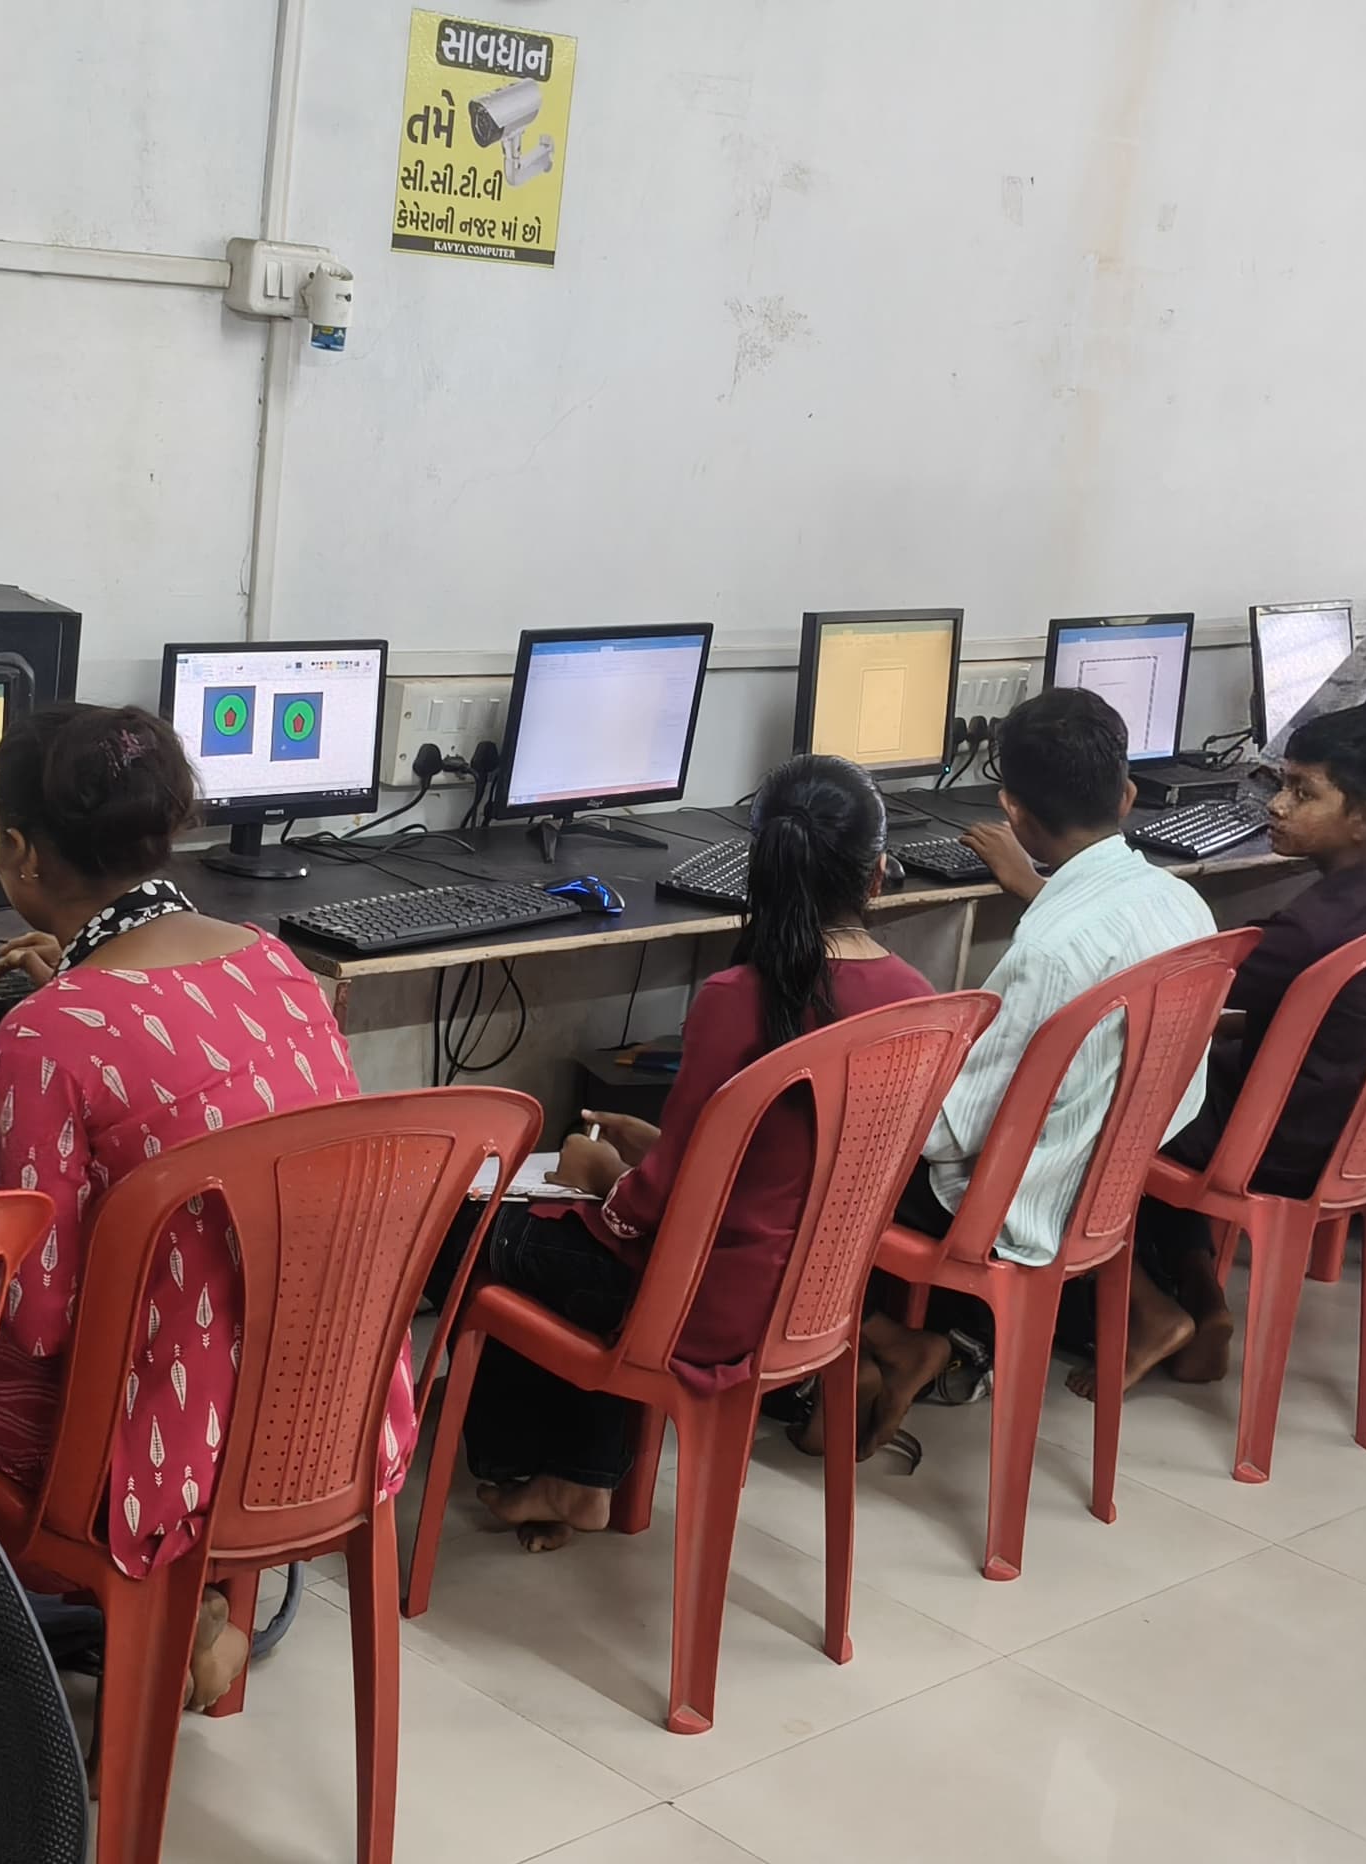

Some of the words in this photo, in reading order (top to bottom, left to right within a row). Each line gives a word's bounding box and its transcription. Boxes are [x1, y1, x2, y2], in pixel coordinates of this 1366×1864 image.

[440, 27, 549, 76] સાવધાન
[406, 89, 456, 149] તમે
[396, 199, 455, 234] કેમેરાની
[459, 216, 497, 239] નજર
[501, 216, 518, 241] માં
[522, 216, 541, 244] છો
[434, 240, 466, 254] KAVYA
[467, 244, 516, 259] COMPUTER
